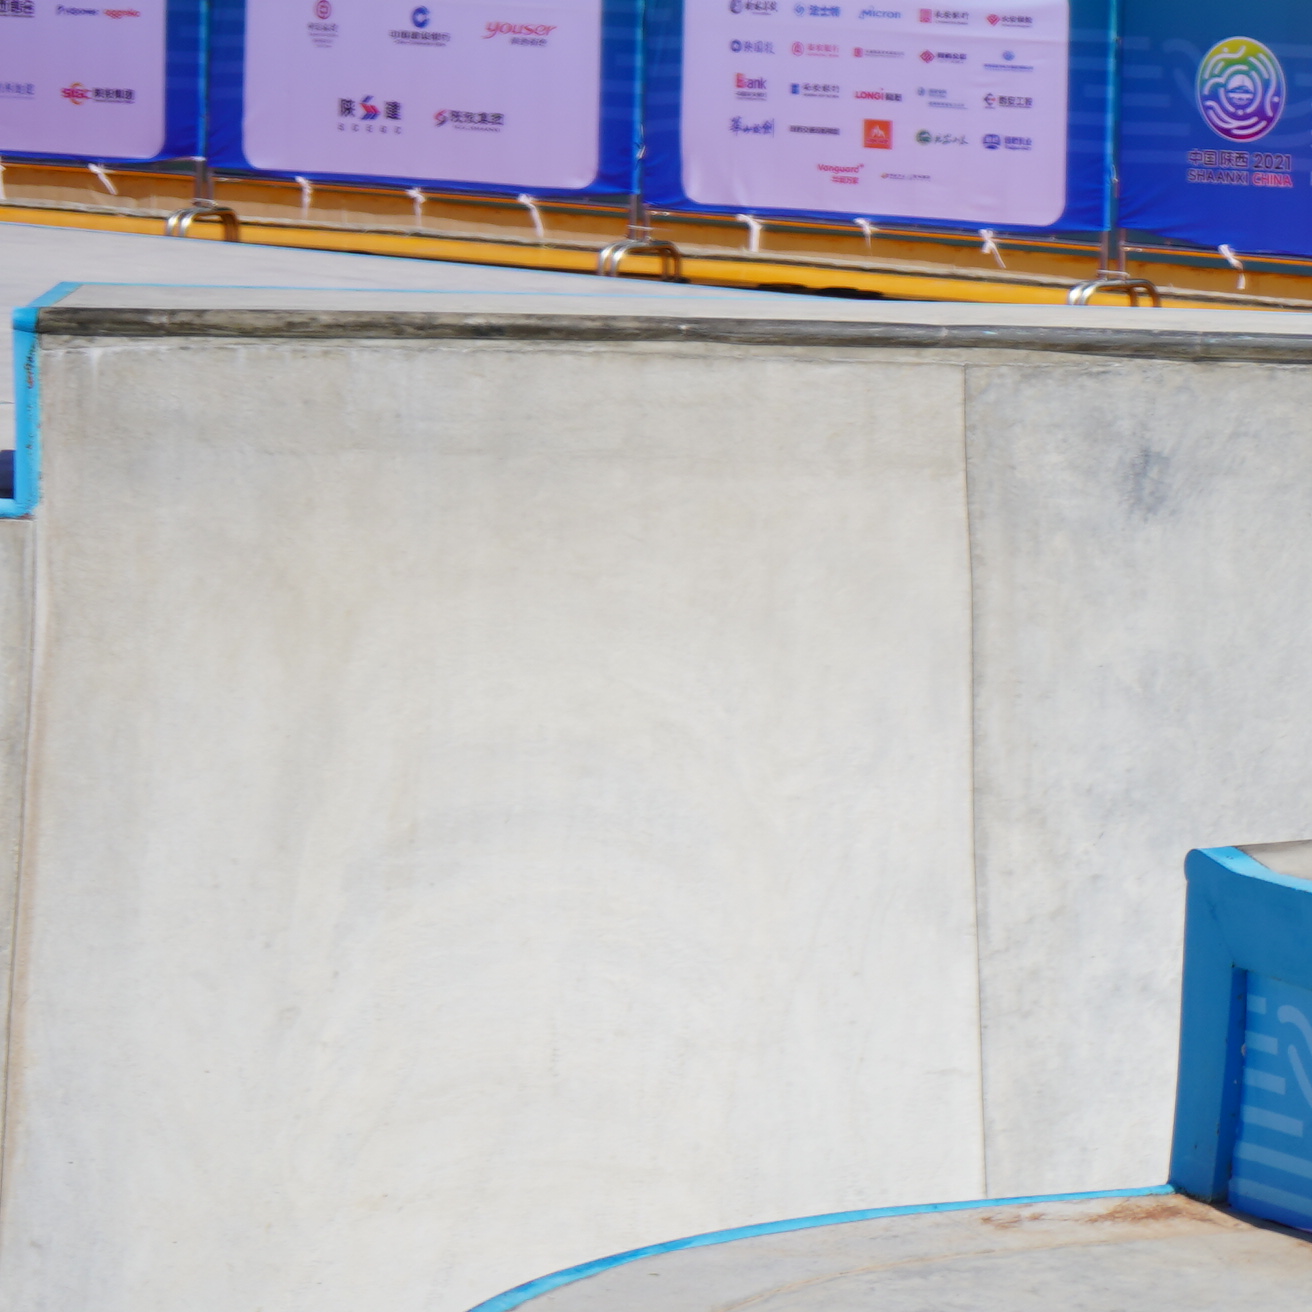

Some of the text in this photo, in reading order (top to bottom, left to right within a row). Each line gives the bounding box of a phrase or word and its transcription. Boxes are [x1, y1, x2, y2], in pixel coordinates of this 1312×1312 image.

[858, 7, 901, 19] Micron
[1187, 148, 1293, 172] 中国陕西 2021
[1187, 168, 1294, 189] SHAANXI CHINA
